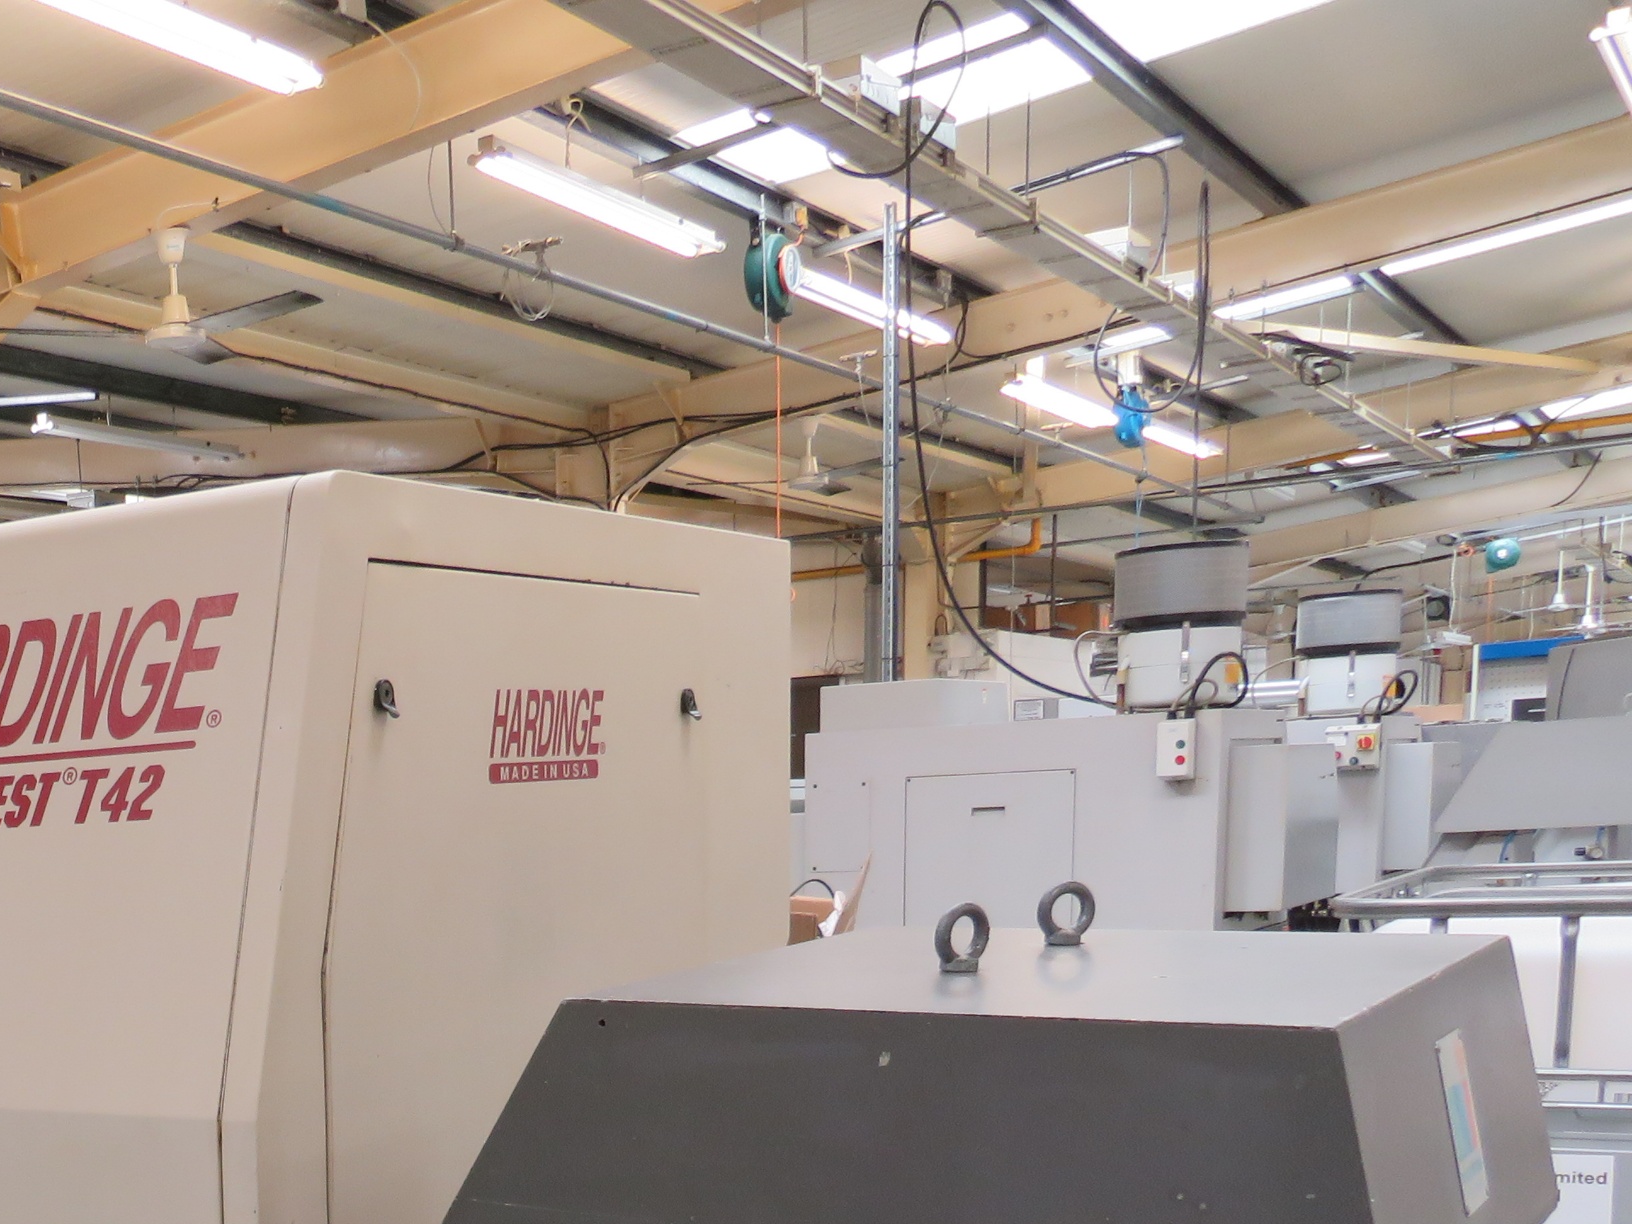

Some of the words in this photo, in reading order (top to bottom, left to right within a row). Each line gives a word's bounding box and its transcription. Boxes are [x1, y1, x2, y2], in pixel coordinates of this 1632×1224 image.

[500, 764, 539, 781] MADE
[543, 764, 558, 779] IN
[563, 762, 589, 778] USA
[74, 764, 166, 824] T42
